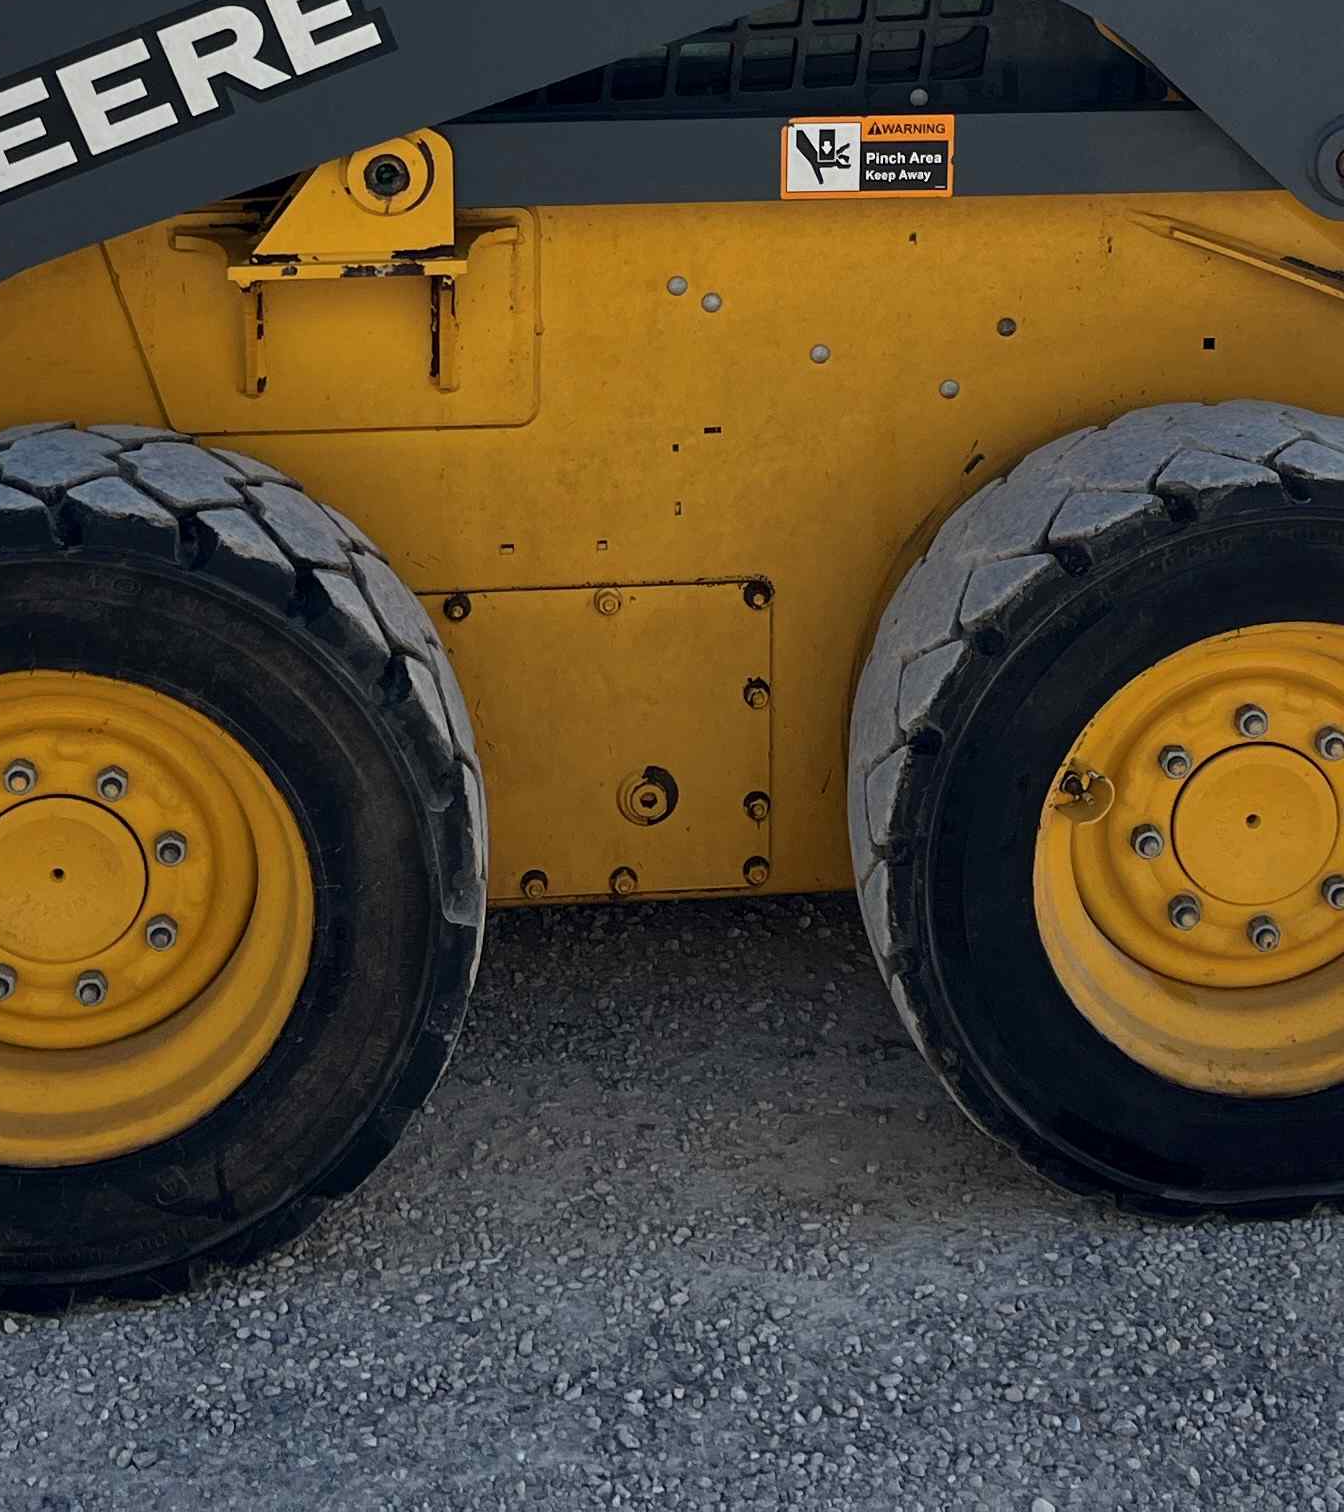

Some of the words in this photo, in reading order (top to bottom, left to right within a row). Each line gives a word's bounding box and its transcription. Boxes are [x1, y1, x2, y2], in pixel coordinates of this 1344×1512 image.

[882, 123, 946, 135] WARNING
[865, 152, 906, 165] Pinch
[908, 152, 942, 164] Area
[865, 170, 896, 182] Keep
[899, 169, 931, 182] Away
